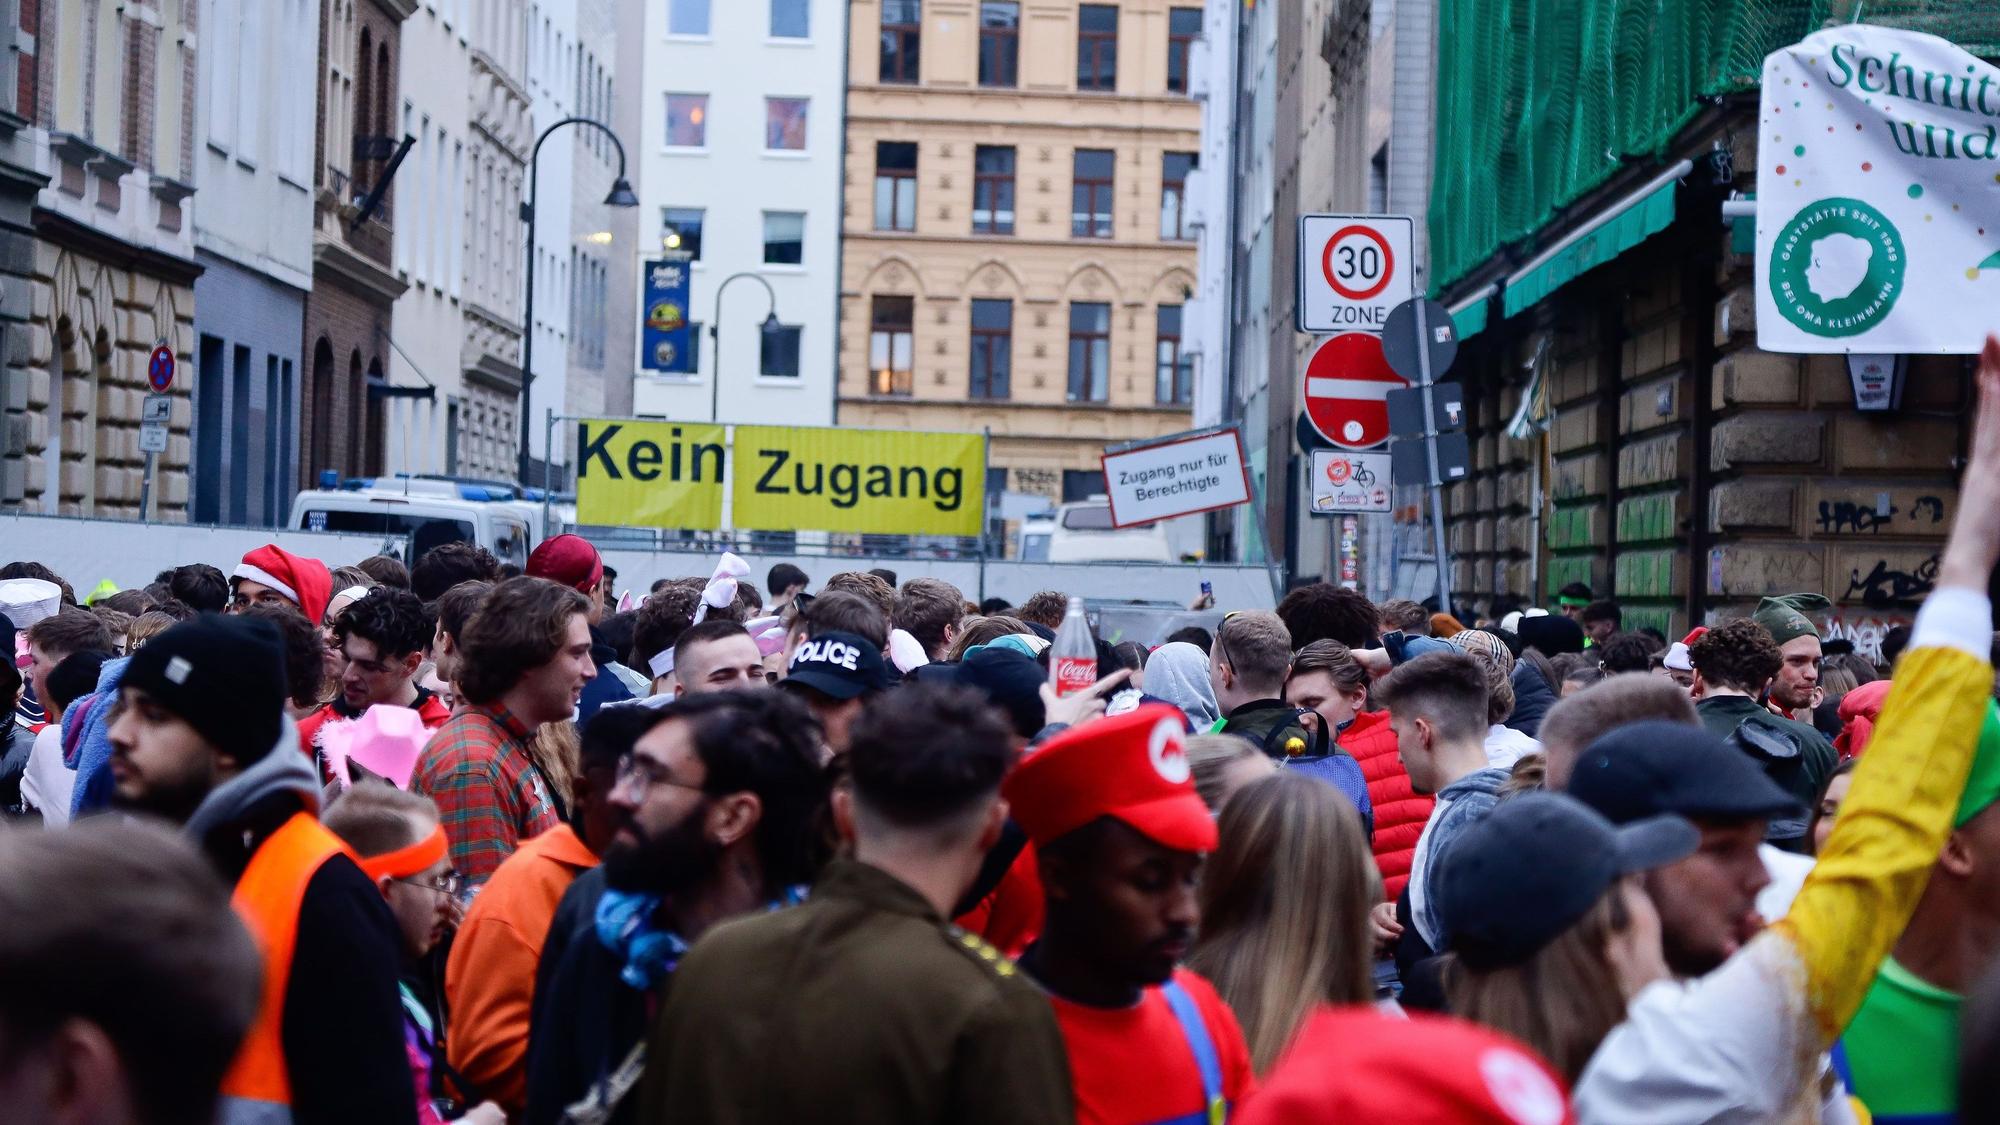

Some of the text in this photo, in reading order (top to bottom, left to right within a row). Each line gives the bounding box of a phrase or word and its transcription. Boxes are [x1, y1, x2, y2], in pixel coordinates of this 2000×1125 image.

[1826, 44, 2000, 117] Schnit
[1885, 118, 1999, 160] und
[1781, 207, 1898, 261] GASTSTÄTTE SEIT 1949
[1338, 246, 1378, 279] 30
[1332, 305, 1387, 324] ZONE
[1781, 281, 1893, 328] BEI OMA KLEINMANN
[577, 423, 725, 484] Kein
[755, 449, 963, 512] Zugang
[1120, 453, 1229, 486] Zugang nur für
[1135, 475, 1220, 502] Berechtigte
